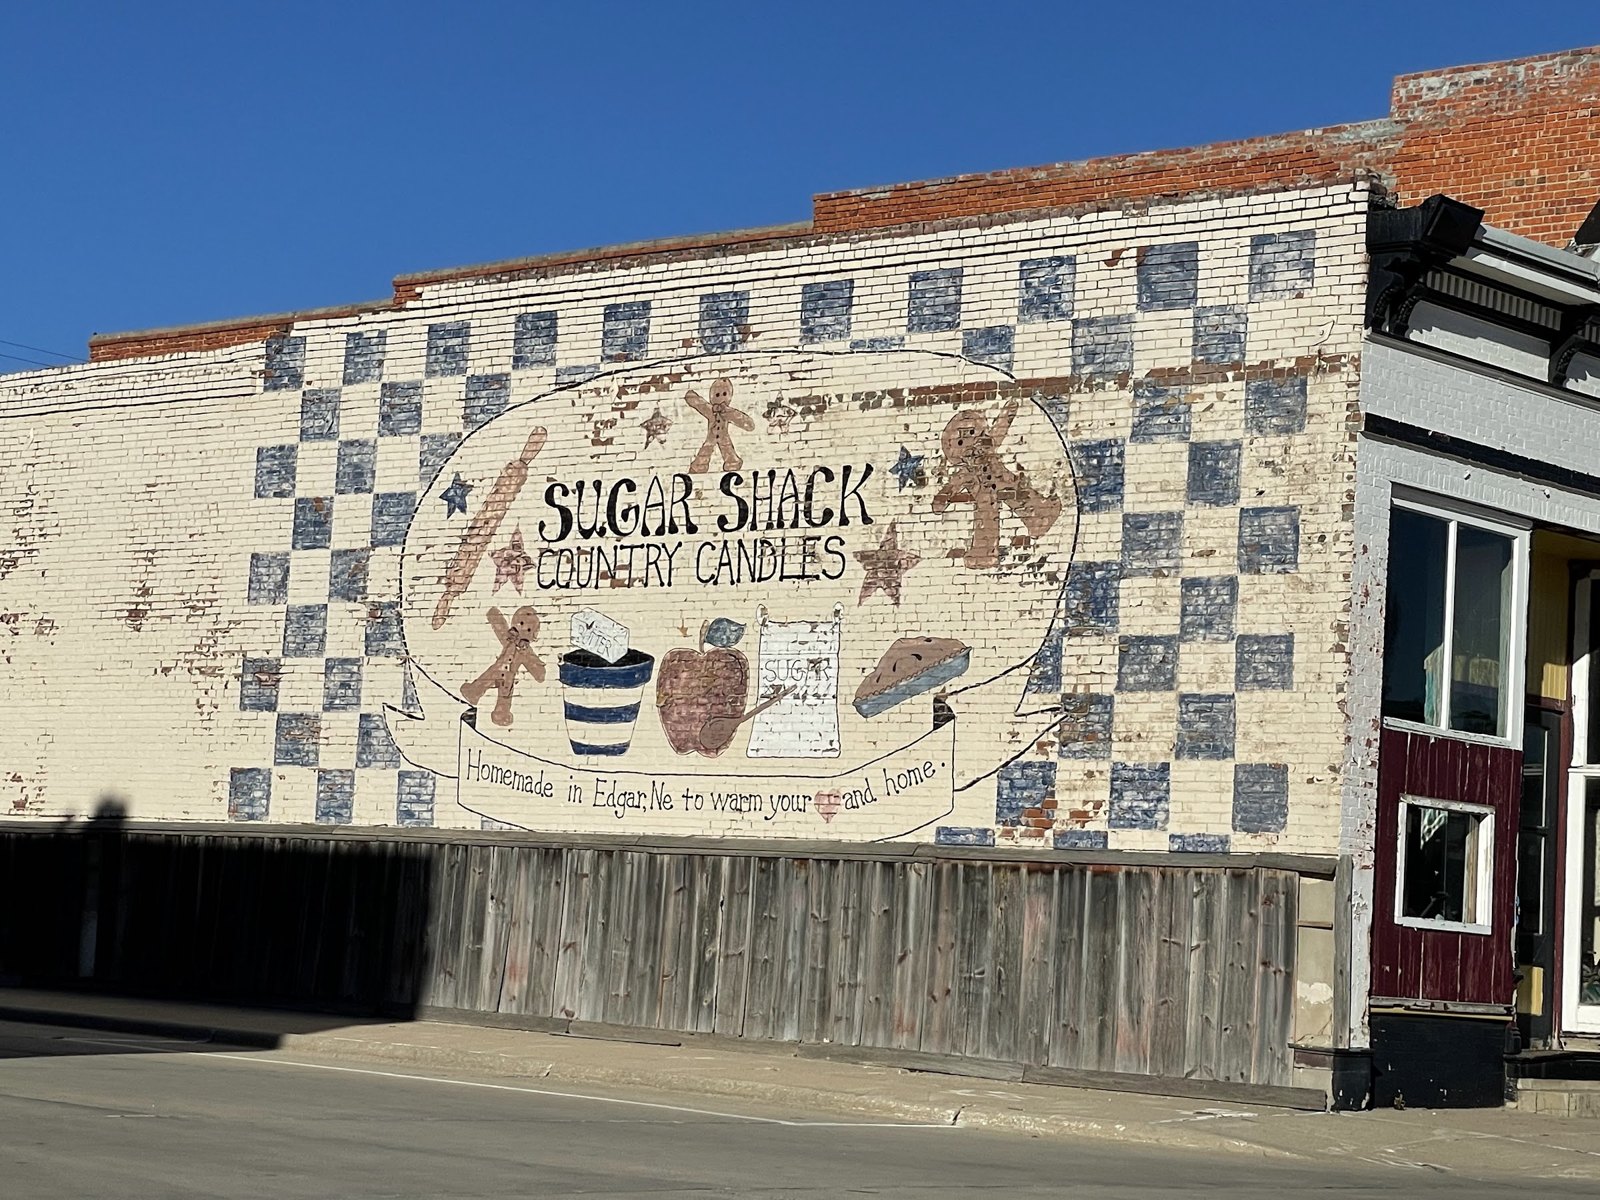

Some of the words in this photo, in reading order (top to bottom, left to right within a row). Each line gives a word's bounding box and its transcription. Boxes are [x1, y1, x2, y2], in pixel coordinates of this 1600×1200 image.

[538, 472, 699, 543] SUGAR
[717, 462, 874, 533] SHACK
[537, 541, 682, 590] COUNTRY
[696, 535, 846, 586] CANDLES
[763, 658, 832, 683] SUGAR
[466, 748, 554, 798] Homemade
[567, 776, 583, 804] in
[682, 787, 704, 811] to
[710, 792, 763, 812] warm
[764, 793, 812, 821] your
[842, 777, 878, 810] and
